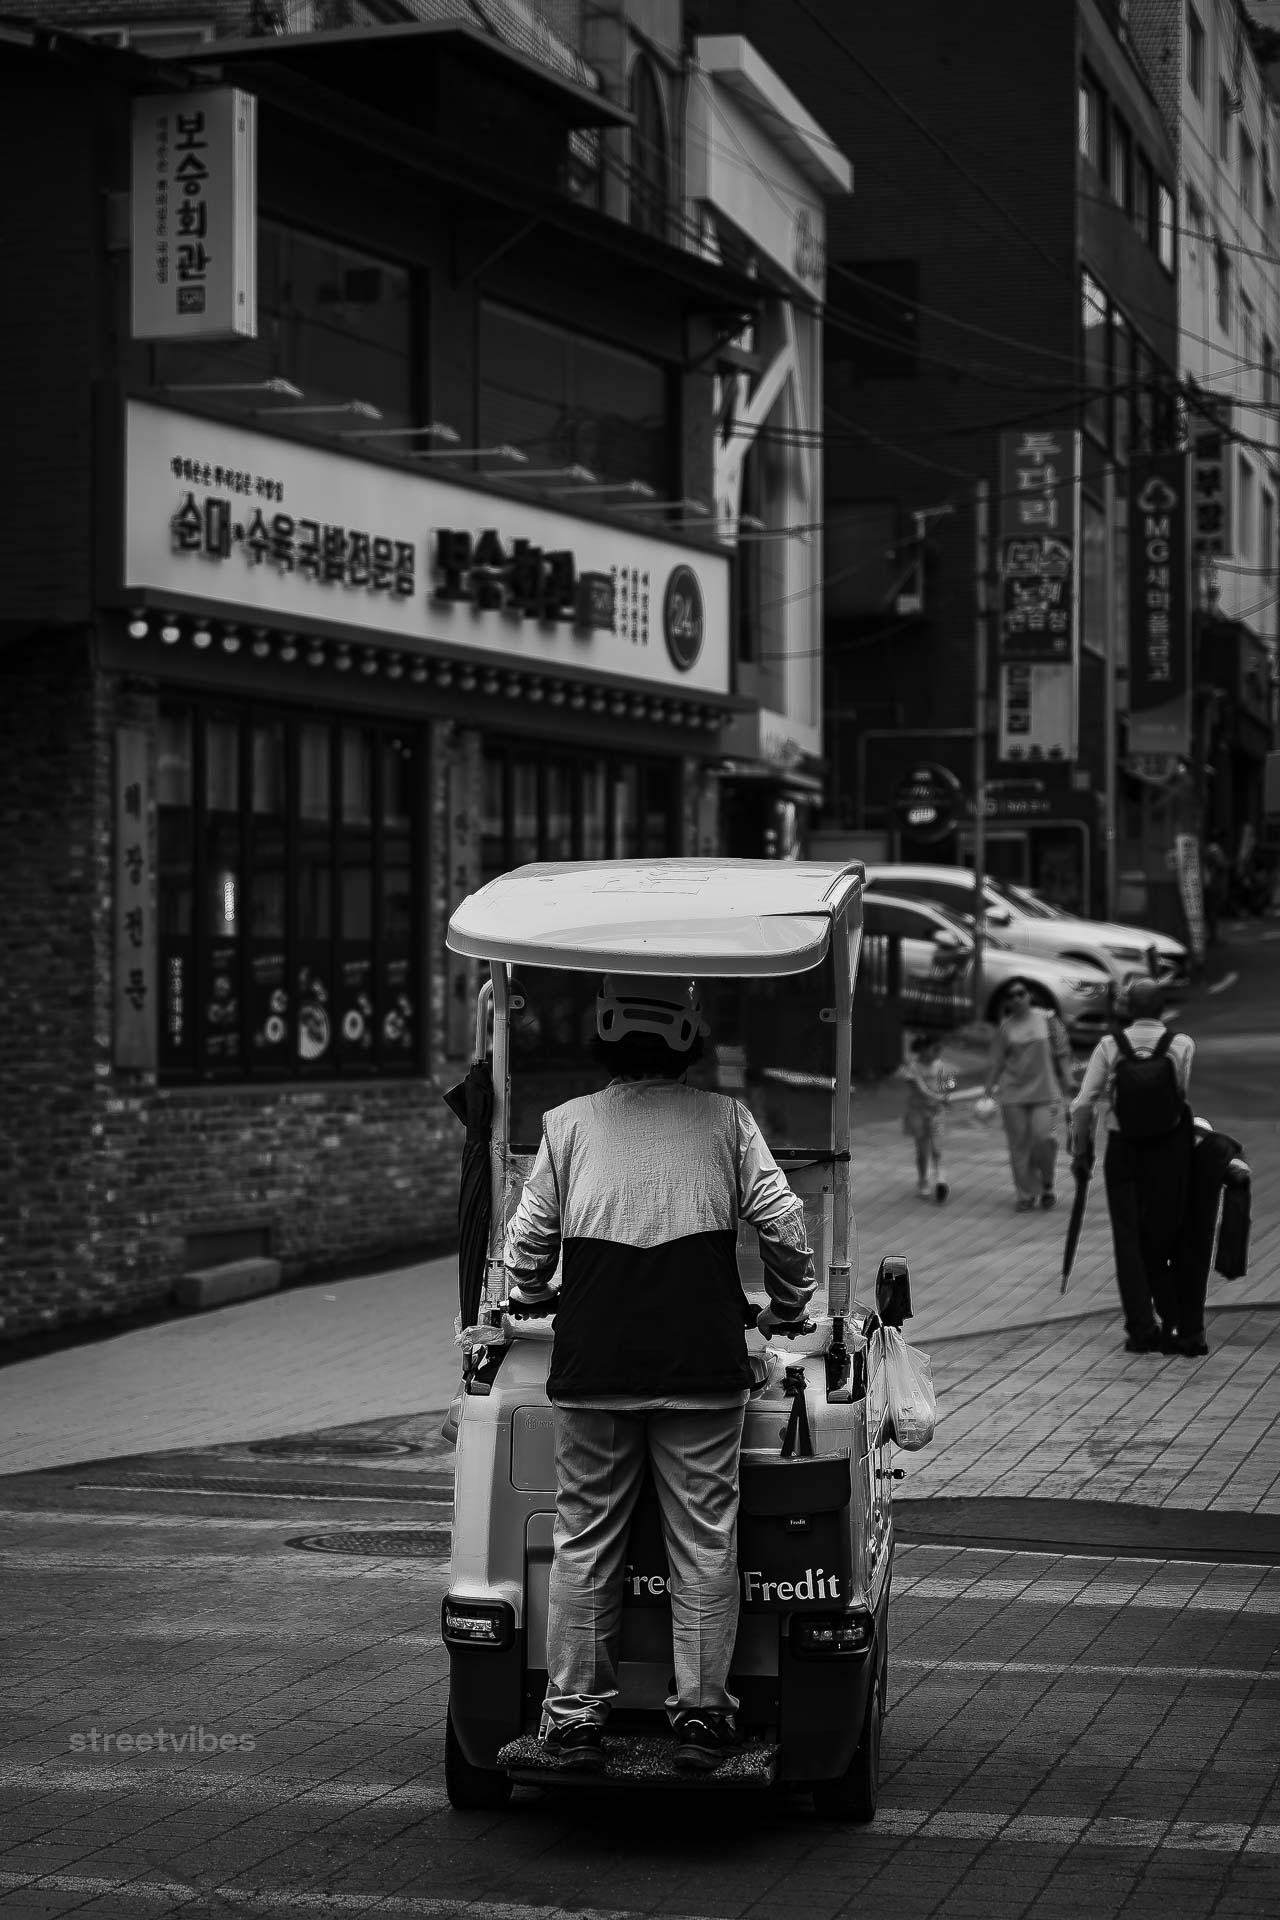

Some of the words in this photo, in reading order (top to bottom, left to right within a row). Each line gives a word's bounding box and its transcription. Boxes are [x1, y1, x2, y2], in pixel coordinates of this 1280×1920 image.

[174, 110, 211, 282] 보승회관
[1015, 432, 1062, 529] 투다리
[789, 1518, 806, 1526] Fredit
[744, 1568, 841, 1602] Fredit
